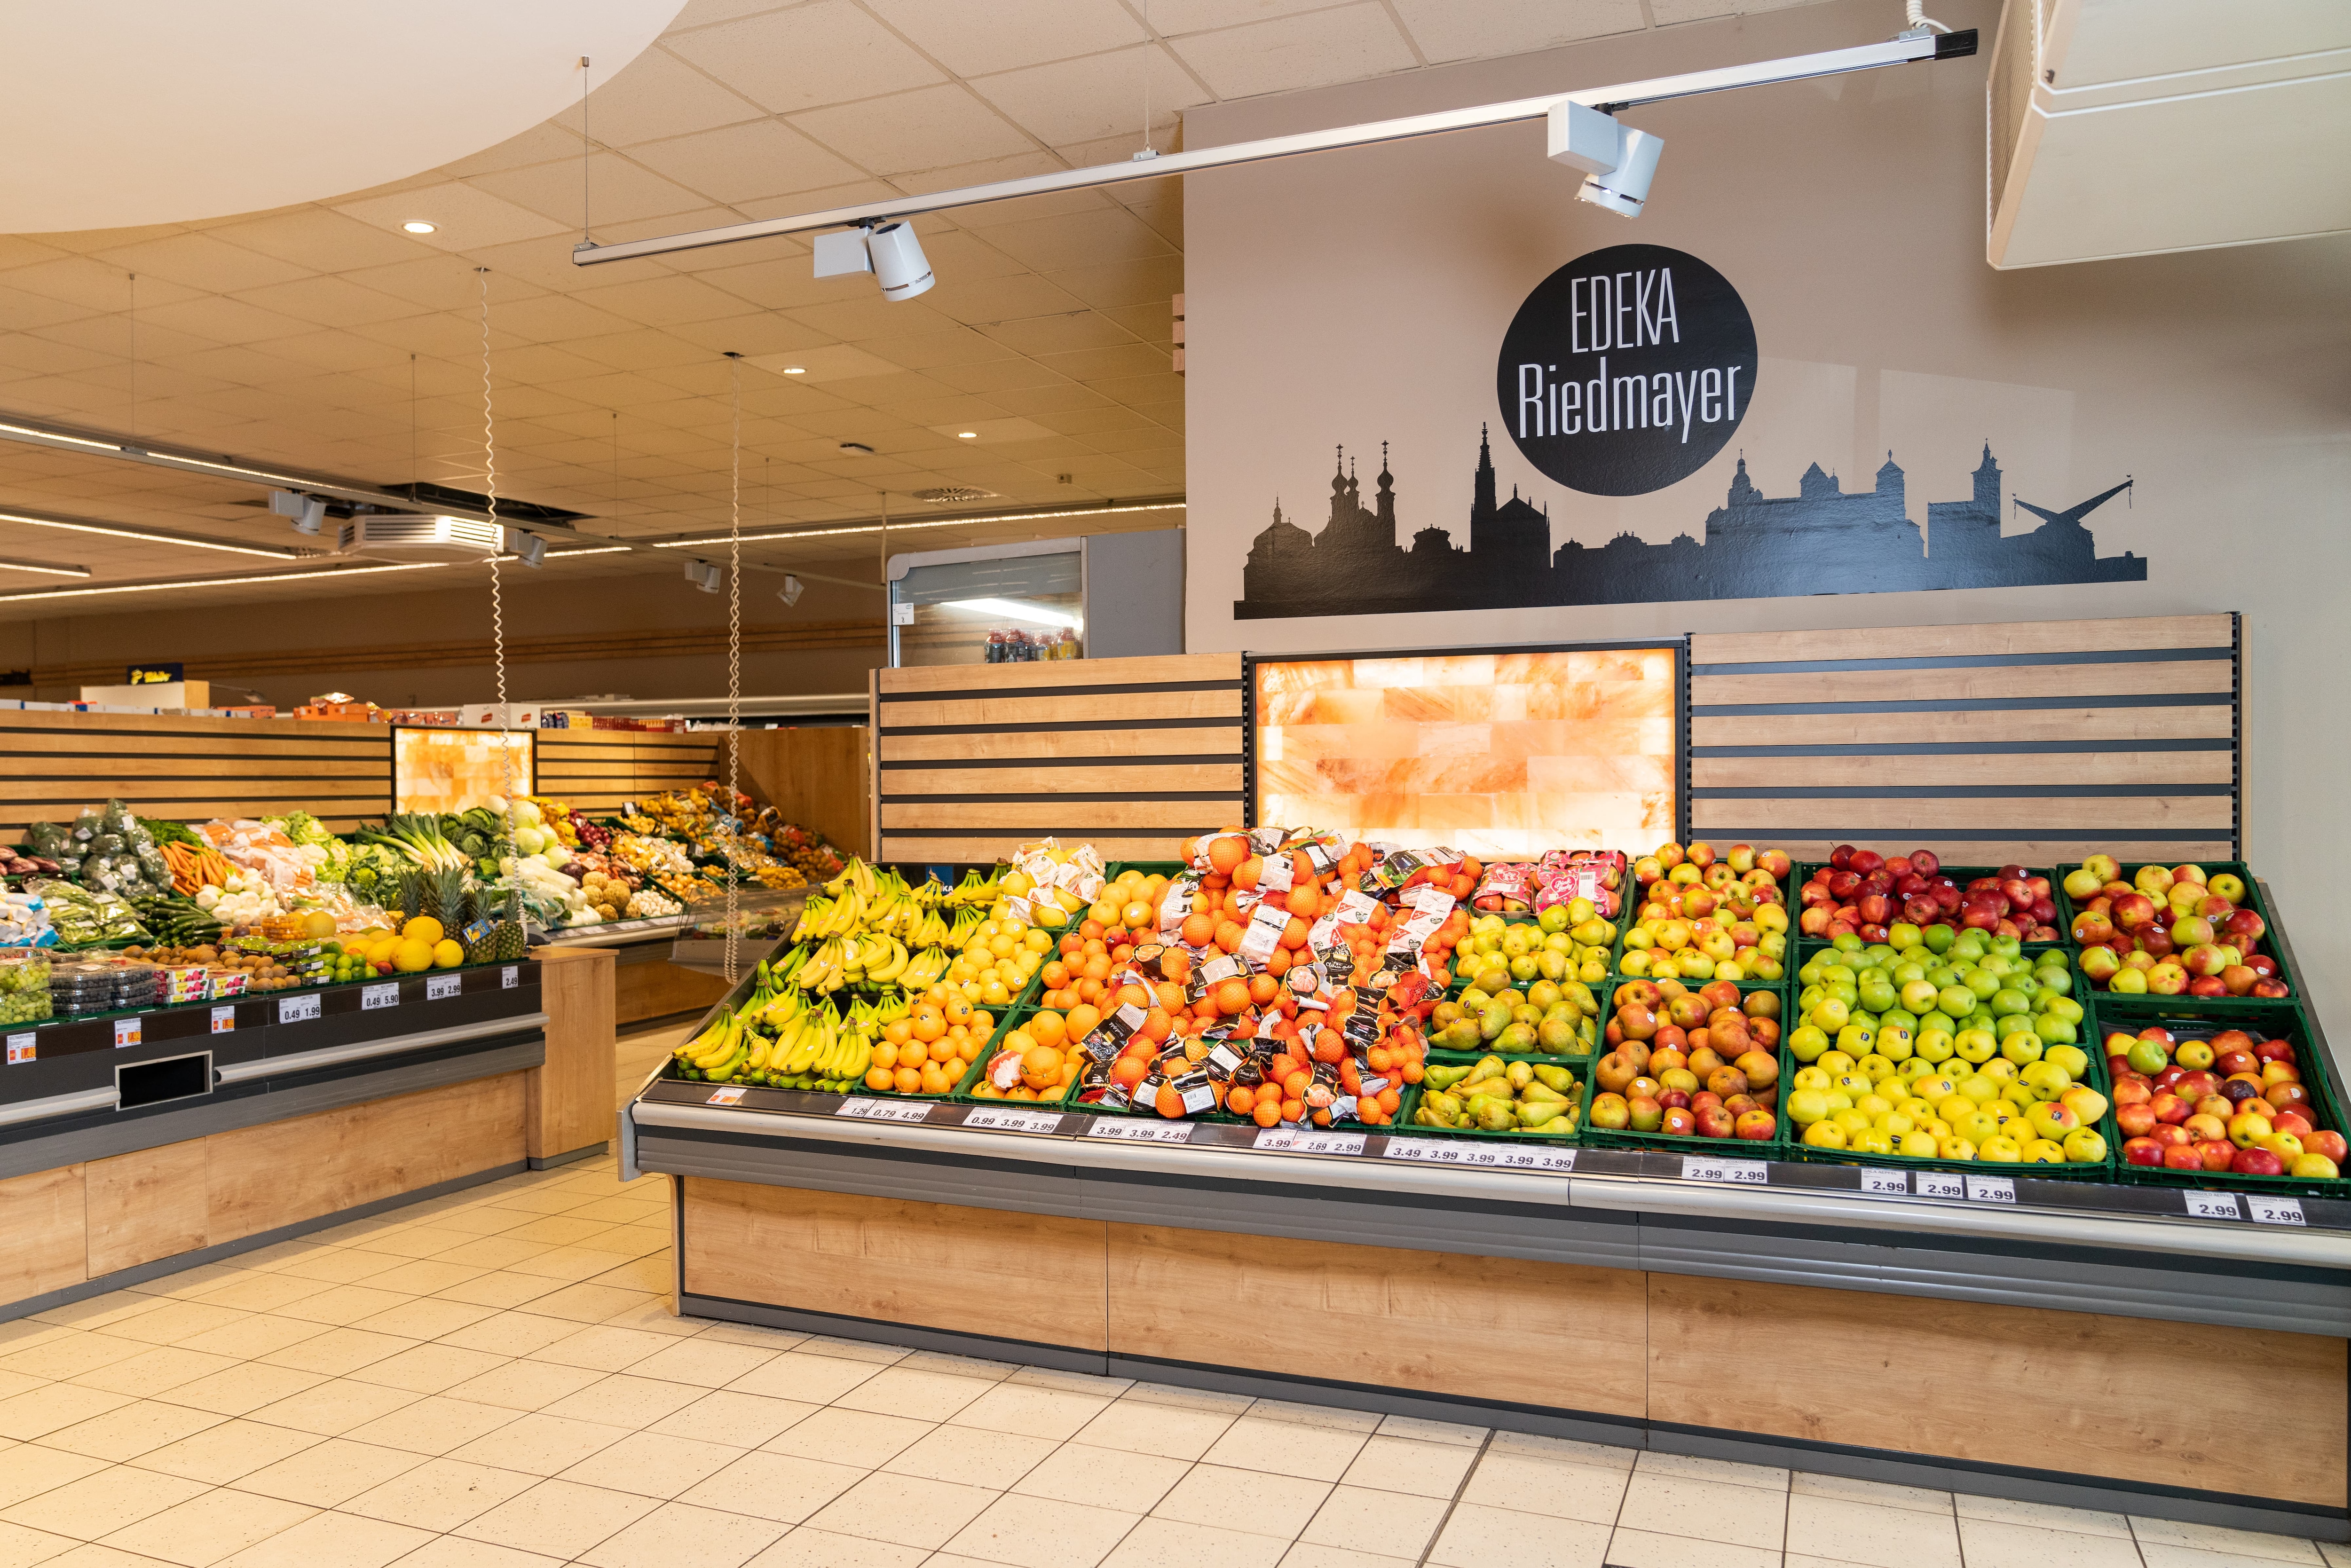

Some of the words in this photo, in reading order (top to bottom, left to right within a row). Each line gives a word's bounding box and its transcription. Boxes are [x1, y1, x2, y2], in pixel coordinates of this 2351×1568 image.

[1571, 268, 1679, 354] EDEKA
[1518, 356, 1741, 444] Riedmayer
[1554, 877, 1572, 888] Pink
[1556, 883, 1573, 893] Lady
[506, 977, 517, 986] 2.49
[432, 987, 444, 997] 3.99
[448, 985, 460, 994] 2.99
[367, 997, 380, 1007] 0.49
[385, 994, 398, 1004] 5.90
[285, 1009, 300, 1020] 0.49
[306, 1006, 320, 1016] 1.99
[223, 1019, 234, 1029] 1.99
[128, 1031, 141, 1043] 2.99
[21, 1047, 36, 1059] 1.49
[1001, 1119, 1026, 1127] 3.99
[1030, 1122, 1055, 1131] 3.99
[1097, 1127, 1122, 1135] 3.99
[1161, 1131, 1187, 1140] 2.49
[1264, 1139, 1291, 1148] 3.99
[1307, 1142, 1327, 1150] 2.69
[1393, 1148, 1421, 1157] 3.49
[1430, 1150, 1458, 1160] 3.99
[1467, 1153, 1495, 1163] 3.99
[1505, 1155, 1533, 1165] 3.99
[1542, 1158, 1571, 1168] 3.99
[1692, 1169, 1722, 1179] 2.99
[1735, 1171, 1765, 1180] 2.99
[1873, 1181, 1905, 1191] 2.99
[1928, 1184, 1960, 1195] 2.99
[1980, 1189, 2013, 1200] 2.99
[2199, 1204, 2237, 1216] 2.99
[2264, 1209, 2303, 1221] 2.99
